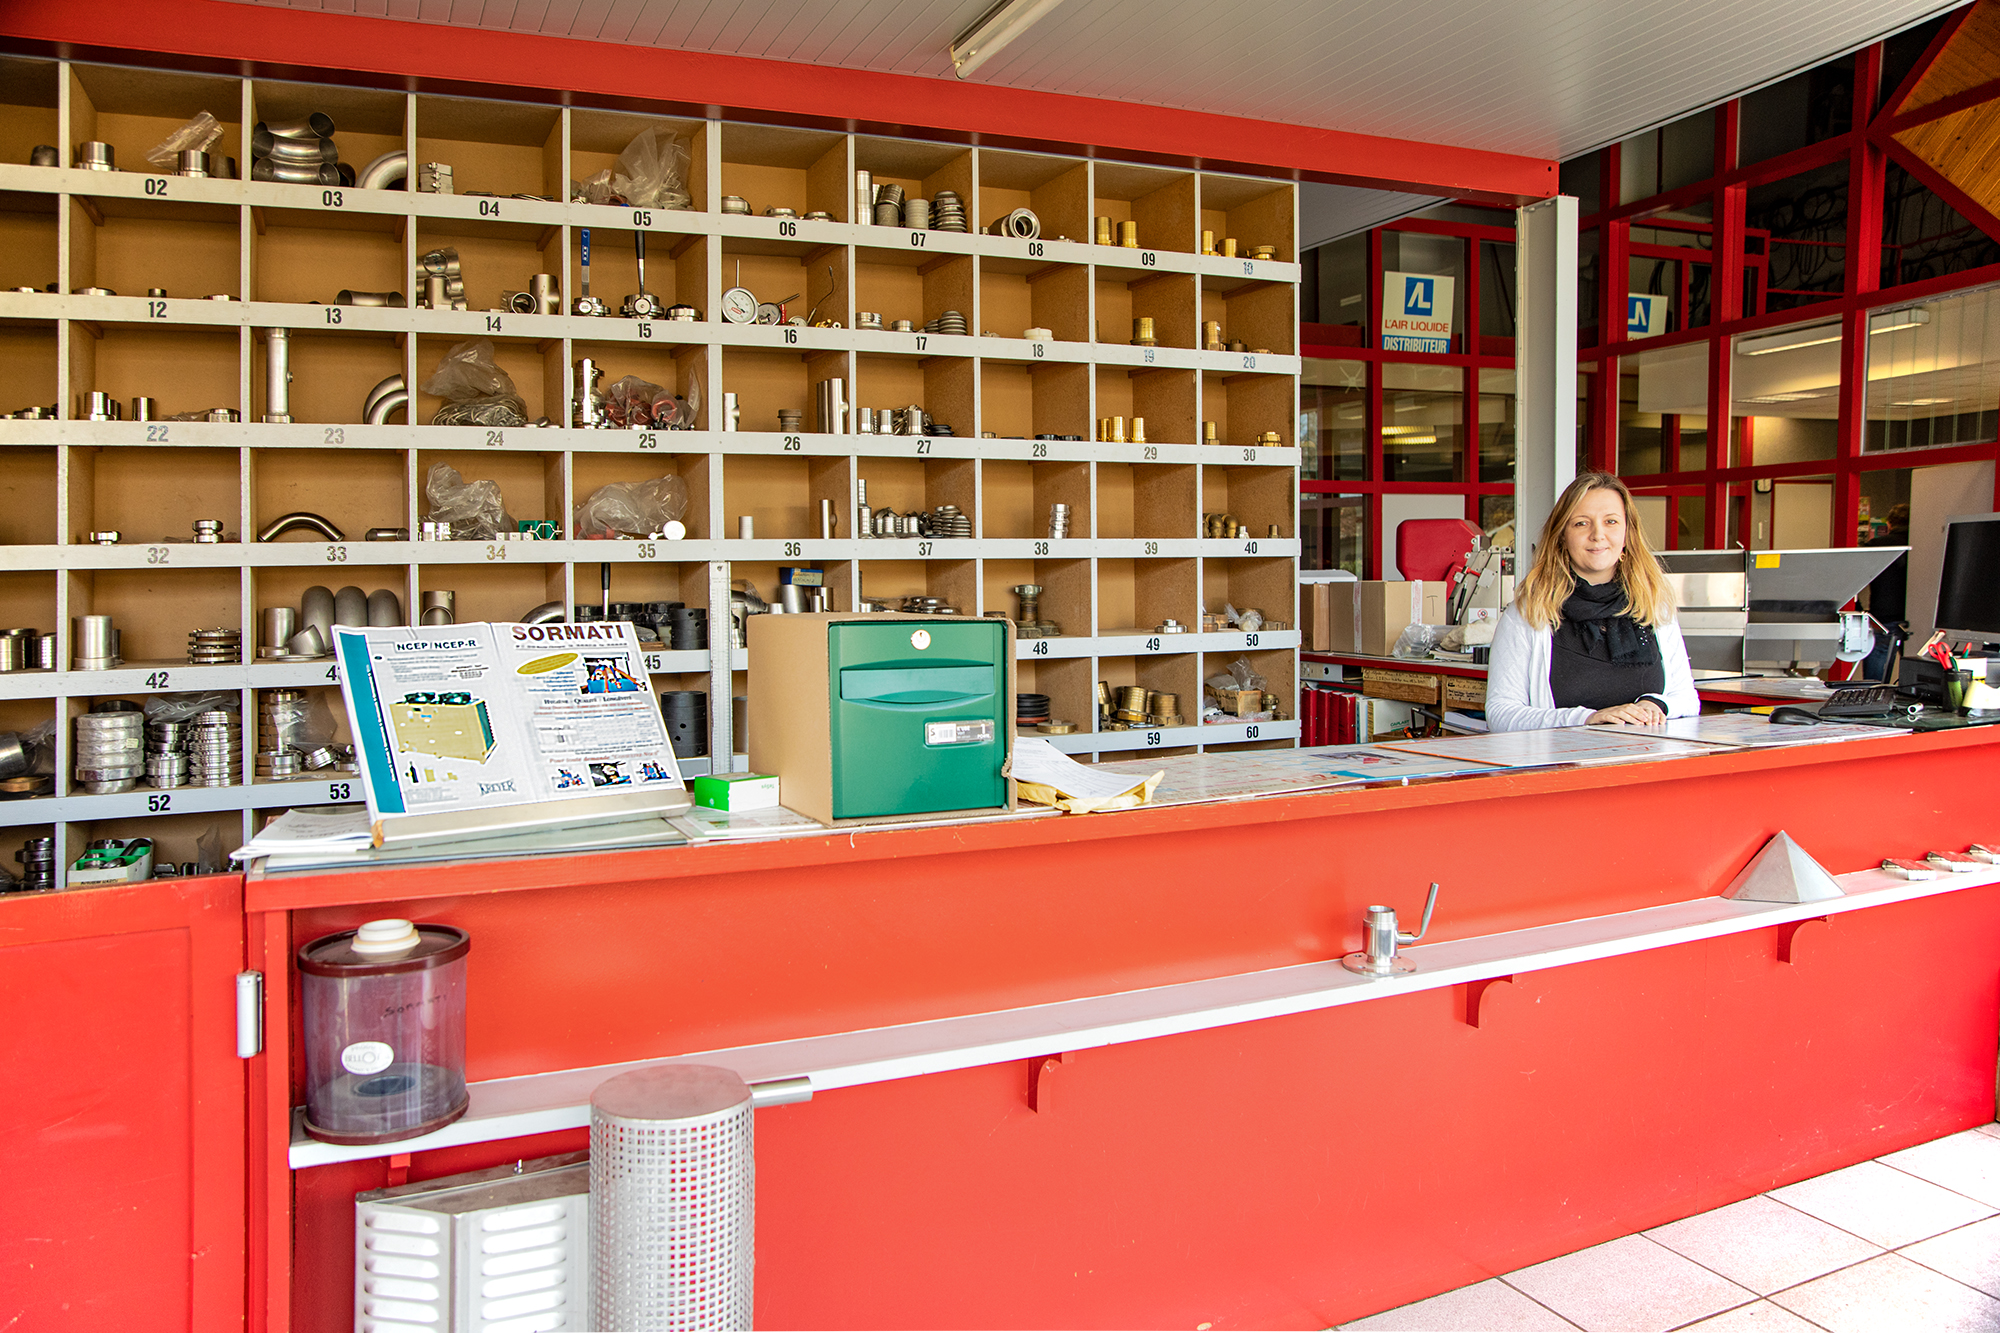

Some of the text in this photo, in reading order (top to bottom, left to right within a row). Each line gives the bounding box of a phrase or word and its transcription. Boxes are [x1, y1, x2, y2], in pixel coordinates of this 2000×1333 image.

[145, 179, 167, 196] 02
[323, 191, 343, 207] 03
[480, 201, 499, 216] 04
[634, 211, 651, 226] 05
[780, 222, 796, 236] 06
[912, 232, 925, 246] 07
[1029, 243, 1043, 256] 08
[1142, 253, 1155, 266] 09
[1243, 262, 1254, 275] 10
[149, 302, 167, 318] 12
[326, 308, 341, 324] 13
[486, 316, 501, 331] 14
[638, 323, 651, 338] 15
[1384, 319, 1449, 332] L'AIR LIQUIDE
[784, 329, 797, 343] 16
[916, 337, 927, 350] 17
[1033, 344, 1043, 357] 18
[1384, 336, 1447, 354] DISTRIBUTEUR
[1144, 350, 1154, 363] 19
[1243, 356, 1256, 369] 20
[147, 426, 168, 441] 22
[324, 428, 344, 444] 23
[487, 431, 504, 446] 24
[639, 433, 656, 449] 25
[784, 436, 800, 450] 26
[917, 440, 931, 453] 27
[1033, 444, 1046, 457] 28
[1145, 447, 1157, 459] 29
[1243, 449, 1256, 462] 30
[327, 546, 346, 561] 33
[487, 545, 507, 560] 34
[639, 544, 655, 558] 35
[785, 542, 800, 556] 36
[919, 542, 932, 556] 37
[1035, 542, 1048, 555] 38
[1145, 542, 1157, 554] 39
[1245, 542, 1257, 554] 40
[148, 548, 168, 563] 32
[511, 625, 625, 641] SORMATI
[1247, 634, 1258, 646] 50
[1033, 642, 1047, 654] 48
[1146, 638, 1159, 650] 49
[644, 654, 661, 669] 45
[146, 672, 169, 688] 42
[325, 665, 340, 681] 4
[1148, 732, 1160, 745] 59
[1247, 726, 1258, 738] 60
[330, 783, 350, 799] 53
[149, 795, 170, 812] 52
